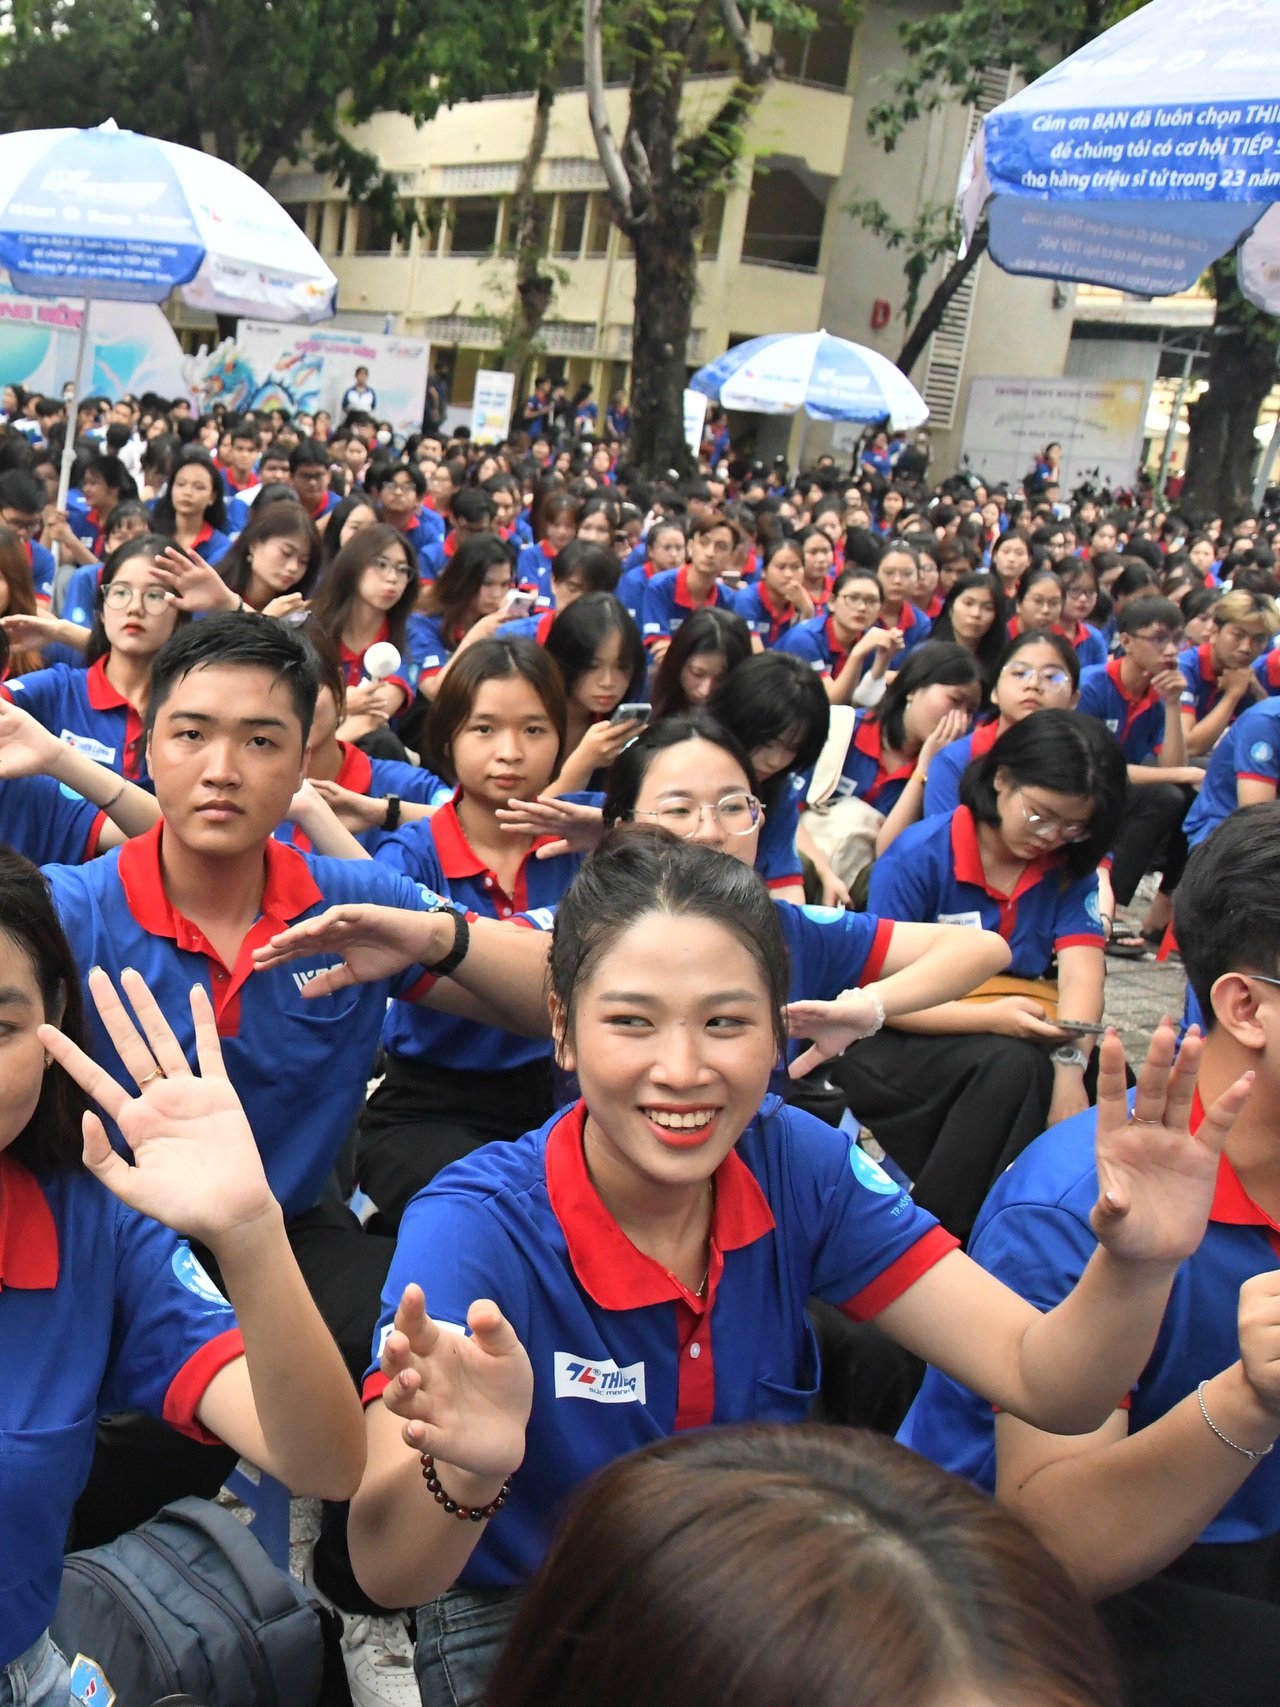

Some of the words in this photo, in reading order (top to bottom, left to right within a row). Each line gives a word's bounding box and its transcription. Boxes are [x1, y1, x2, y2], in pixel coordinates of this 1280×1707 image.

[1092, 112, 1129, 134] BẠN
[1130, 109, 1152, 128] đã
[1154, 107, 1193, 127] luôn
[1196, 105, 1241, 129] chọn
[1074, 140, 1124, 163] chúng
[1127, 138, 1151, 158] tôi
[1152, 138, 1173, 157] có
[1175, 140, 1198, 157] cơ
[1197, 136, 1229, 160] hội
[1232, 131, 1274, 156] TIẾP
[1049, 168, 1091, 192] hàng
[1091, 169, 1131, 192] triệu
[1169, 170, 1217, 192] trong
[1219, 168, 1246, 187] 23
[871, 299, 891, 329] D
